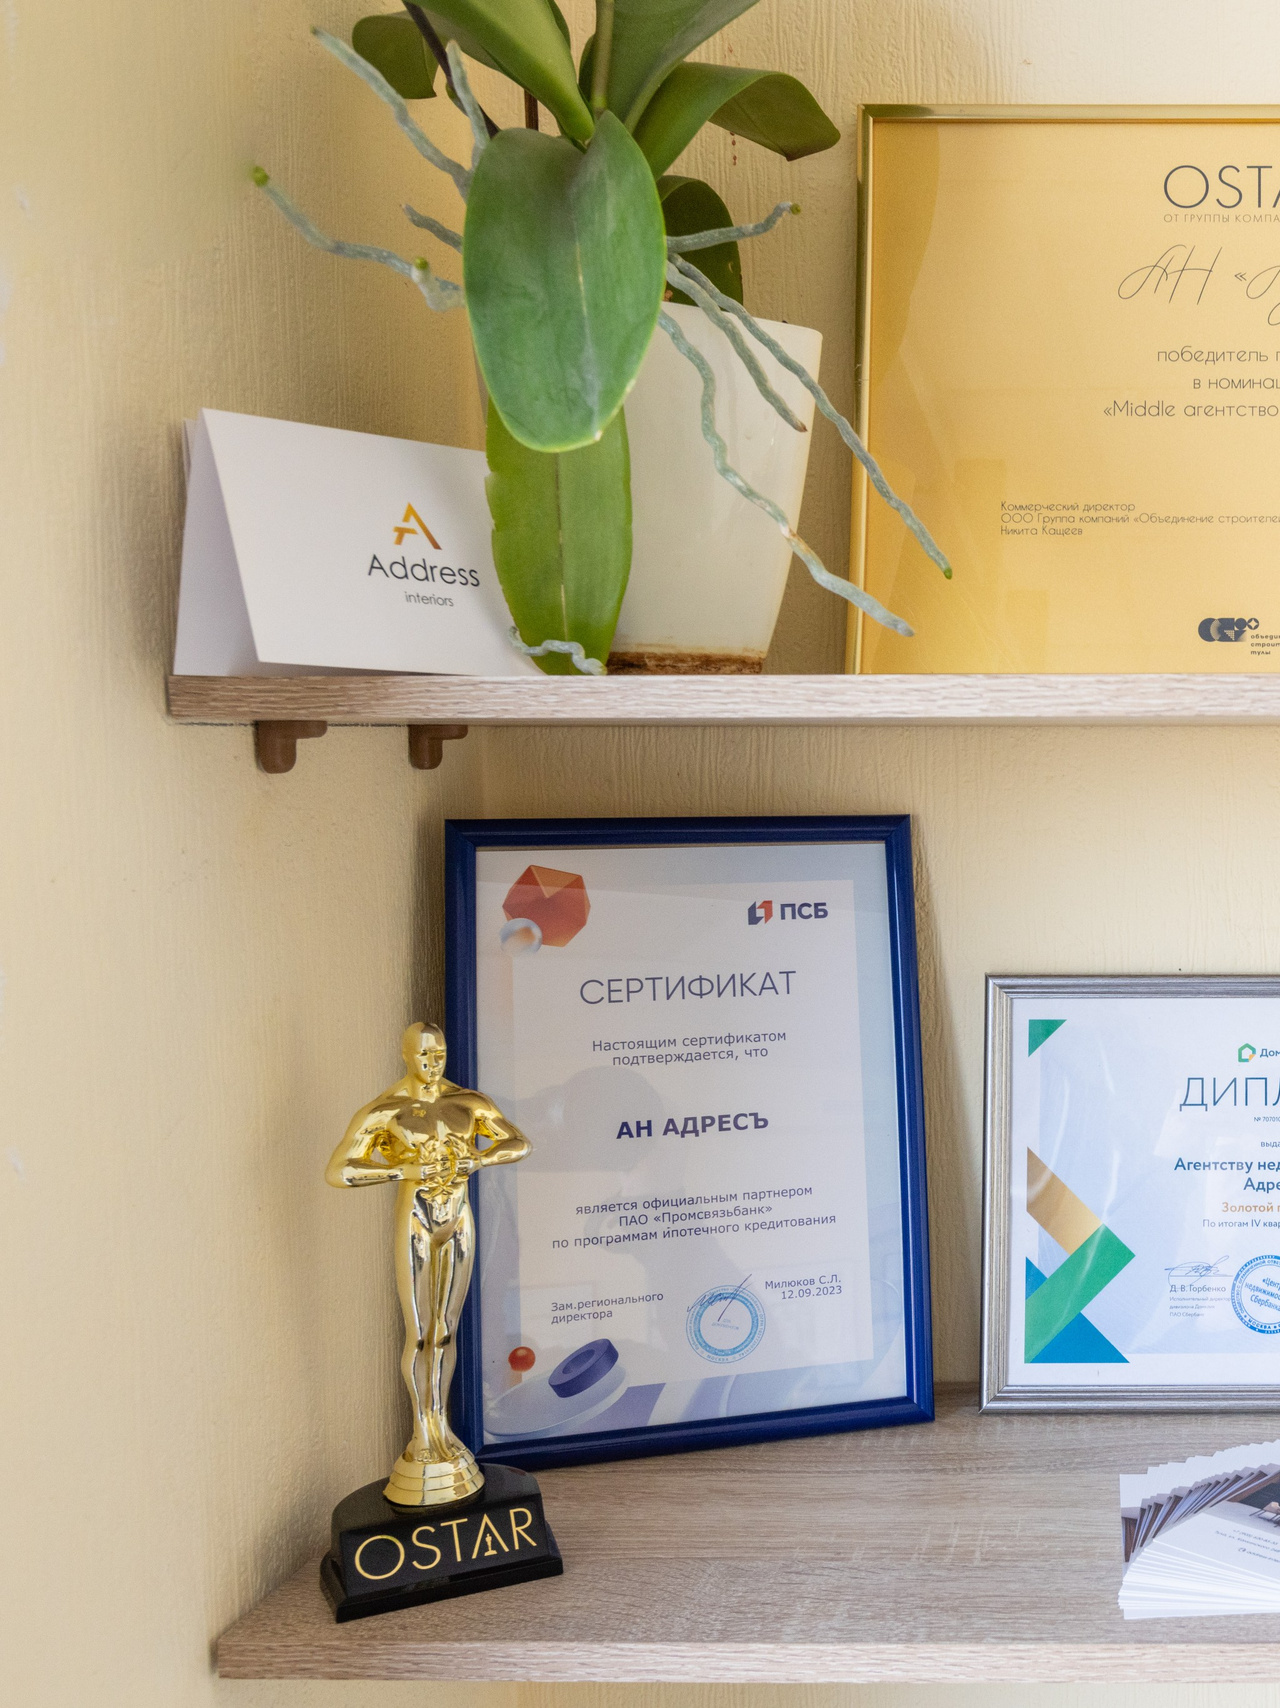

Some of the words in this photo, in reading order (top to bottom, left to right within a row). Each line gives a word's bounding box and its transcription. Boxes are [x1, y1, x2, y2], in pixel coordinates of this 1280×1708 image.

[1164, 214, 1178, 223] ОТ
[1184, 214, 1229, 223] ГРУППЫ
[1157, 346, 1268, 365] победитель
[1193, 378, 1201, 389] в
[1103, 400, 1176, 417] «Middle
[1184, 405, 1279, 417] агентство
[1001, 501, 1079, 512] Коммерческий
[1082, 503, 1136, 512] директор
[1001, 513, 1033, 523] ООО
[1037, 513, 1075, 525] Группа
[1079, 512, 1129, 523] компаний
[1133, 513, 1214, 525] «Объединение
[1001, 525, 1038, 535] Никита
[1041, 525, 1083, 537] Кащеев
[367, 554, 480, 587] Address
[404, 591, 454, 607] interiors
[779, 902, 828, 920] ПСБ
[579, 970, 796, 1005] СЕРТИФИКАТ
[592, 1038, 677, 1052] Настоящим
[682, 1031, 786, 1047] сертификатом
[612, 1051, 738, 1066] подтверждается,
[744, 1048, 768, 1058] что
[616, 1120, 653, 1139] АН
[662, 1112, 769, 1138] АДРЕСЪ
[1174, 1157, 1253, 1173] Агентству
[575, 1201, 638, 1215] является
[642, 1191, 738, 1212] официальным
[742, 1186, 813, 1203] партнером
[1222, 1202, 1274, 1213] Золотой
[618, 1215, 648, 1227] ПАО
[653, 1206, 773, 1225] «Промсвязьбанк»
[1203, 1219, 1216, 1227] По
[1219, 1220, 1249, 1228] итогам
[1251, 1219, 1261, 1227] IV
[552, 1239, 569, 1249] по
[574, 1232, 658, 1249] программам
[662, 1224, 739, 1239] ипотечного
[744, 1215, 836, 1233] кредитования
[765, 1278, 815, 1290] Милюков
[820, 1274, 841, 1286] С.Л.
[1189, 1285, 1226, 1294] Горбенко
[781, 1285, 842, 1300] 12.09.2023
[551, 1292, 664, 1314] Зам.регионального
[551, 1310, 613, 1324] директора
[355, 1507, 537, 1580] OSTAR
